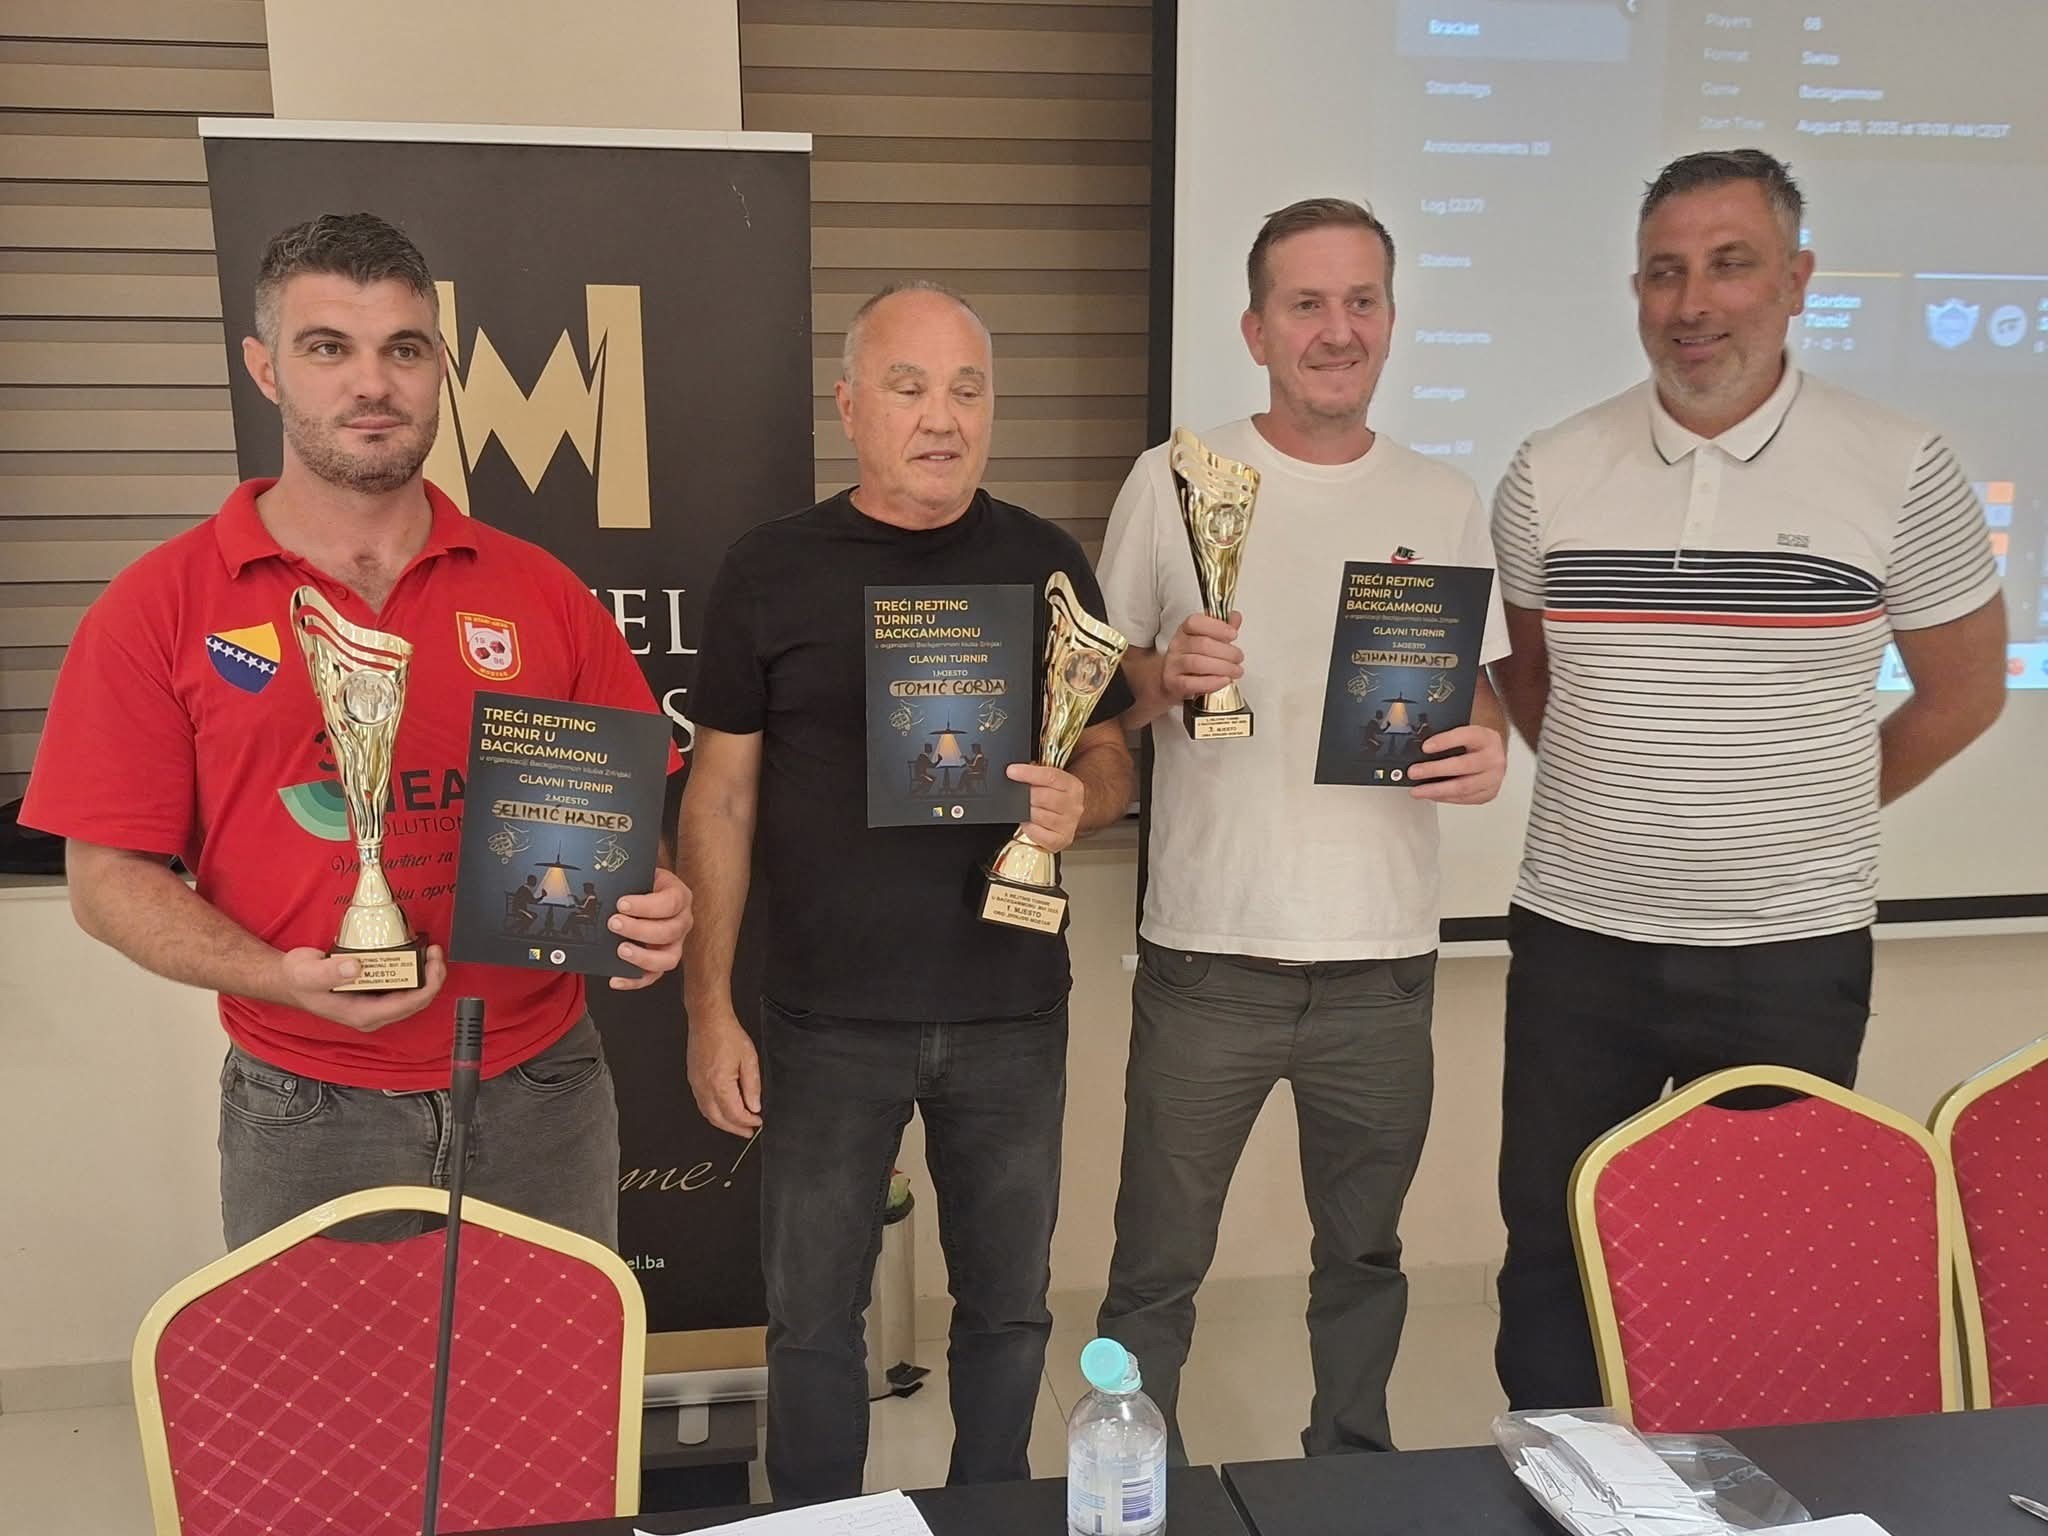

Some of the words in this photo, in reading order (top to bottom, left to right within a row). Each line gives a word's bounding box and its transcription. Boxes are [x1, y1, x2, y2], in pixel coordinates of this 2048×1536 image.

[1429, 20, 1480, 36] Bracket
[1351, 574, 1383, 585] TREĆI
[1386, 576, 1434, 587] REJTING
[1349, 587, 1391, 598] TURNIR
[1394, 590, 1403, 599] U
[874, 598, 911, 611] TREĆI
[915, 600, 968, 611] REJTING
[1346, 600, 1442, 613] BACKGAMMONU
[588, 588, 698, 655] EL
[874, 614, 923, 625] TURNIR
[926, 614, 935, 624] U
[875, 627, 981, 639] BACKGAMMONU
[1373, 626, 1408, 636] GLAVNI
[1410, 628, 1445, 637] TURNIR
[909, 655, 947, 664] GLAVNI
[950, 654, 988, 663] TURNIR
[1401, 653, 1450, 666] HIDAJET
[894, 679, 946, 695] TOMIĆ
[483, 707, 528, 724] TREĆI
[533, 714, 597, 733] REJTING
[481, 723, 540, 741] TURNIR
[544, 731, 556, 743] U
[480, 738, 609, 765] BACKGAMMONU
[519, 773, 565, 787] GLAVNI
[567, 779, 614, 794] TURNIR
[491, 802, 560, 822] SELIMIĆ
[564, 809, 630, 831] HAJDER
[1014, 906, 1042, 918] MJESTO
[618, 1124, 763, 1192] me!
[627, 1255, 665, 1270] el.ba
